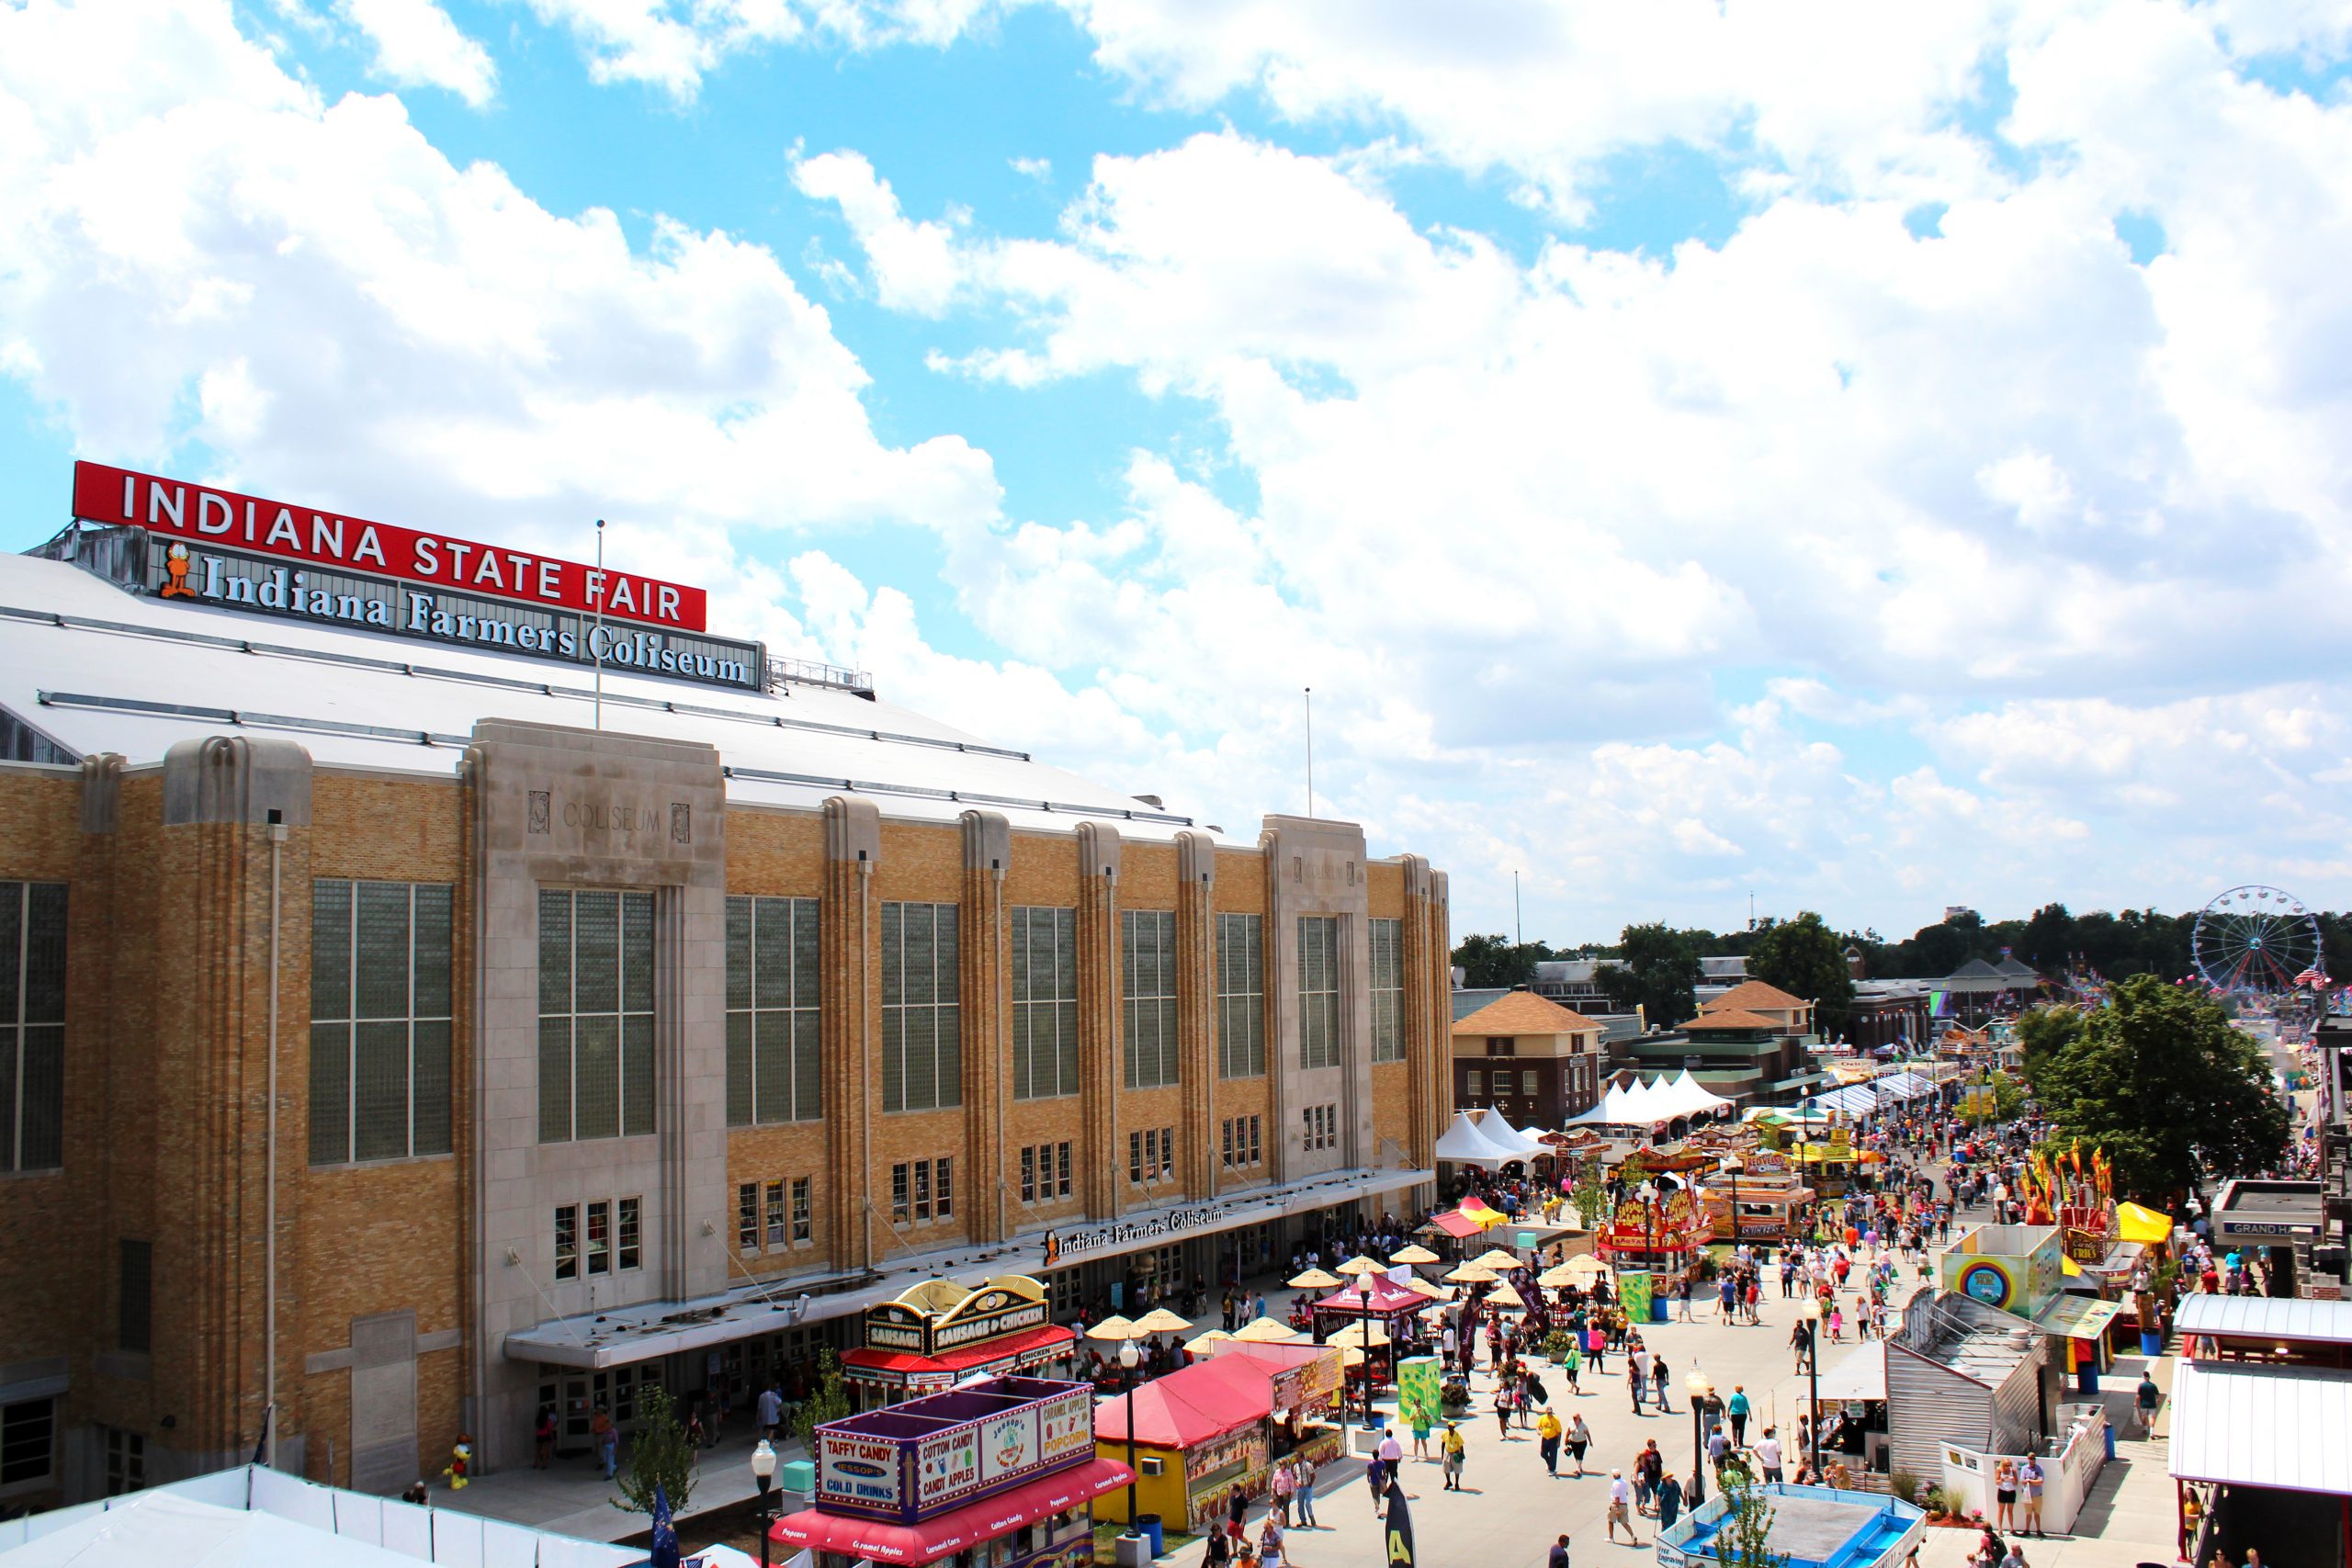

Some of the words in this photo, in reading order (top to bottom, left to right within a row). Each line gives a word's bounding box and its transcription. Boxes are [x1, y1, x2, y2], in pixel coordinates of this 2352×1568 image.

[123, 476, 387, 566] INDIANA
[413, 536, 561, 600] STATE
[584, 571, 682, 622] FAIR
[201, 555, 390, 626] Indiana
[405, 590, 574, 657] Farmers
[588, 625, 748, 683] Coliseum
[563, 803, 661, 832] COLISEUM
[1747, 1157, 1760, 1167] RED
[1057, 1233, 1108, 1256] Indiana
[1114, 1221, 1167, 1244] Farmers
[1170, 1209, 1224, 1232] Coliseum
[1742, 1224, 1779, 1235] SNICKERS
[2233, 1224, 2276, 1235] GRAND
[2278, 1225, 2293, 1234] HA
[2073, 1248, 2097, 1259] FRIES
[1338, 1289, 1363, 1301] Shan
[937, 1319, 989, 1347] SAUSAGE
[1000, 1305, 1044, 1331] CHICKEN
[871, 1327, 920, 1348] SAUSAGE
[1021, 1348, 1051, 1361] CHICKEN
[846, 1368, 878, 1378] CHICKEN
[958, 1366, 989, 1381] SAUSAGE
[1044, 1404, 1067, 1422] CARAMEL
[1068, 1397, 1087, 1415] APPLES
[993, 1419, 1024, 1439] Jessop's
[827, 1439, 856, 1458] TAFFY
[859, 1444, 892, 1462] CANDY
[923, 1439, 950, 1461] COTTON
[952, 1432, 974, 1451] CANDY
[1044, 1429, 1089, 1455] POPCORN
[837, 1463, 883, 1477] JESSOP'S
[827, 1478, 852, 1495] COLD
[856, 1483, 893, 1500] DRINKS
[923, 1476, 945, 1496] CANDY
[949, 1467, 975, 1488] APPLES
[1094, 1476, 1112, 1490] Caramel
[1112, 1472, 1128, 1483] Apples
[1049, 1495, 1069, 1507] Popcorn
[1198, 1468, 1268, 1526] POPORN
[990, 1519, 1008, 1531] Cotton
[1007, 1513, 1023, 1525] Candy
[781, 1528, 808, 1540] Popcorn
[852, 1540, 880, 1553] Caramel
[880, 1545, 904, 1557] Apples
[925, 1542, 947, 1555] Caramel
[946, 1537, 961, 1548] Corn
[1388, 1529, 1412, 1565] A
[1658, 1545, 1670, 1555] Free
[1658, 1552, 1684, 1567] Engraving
